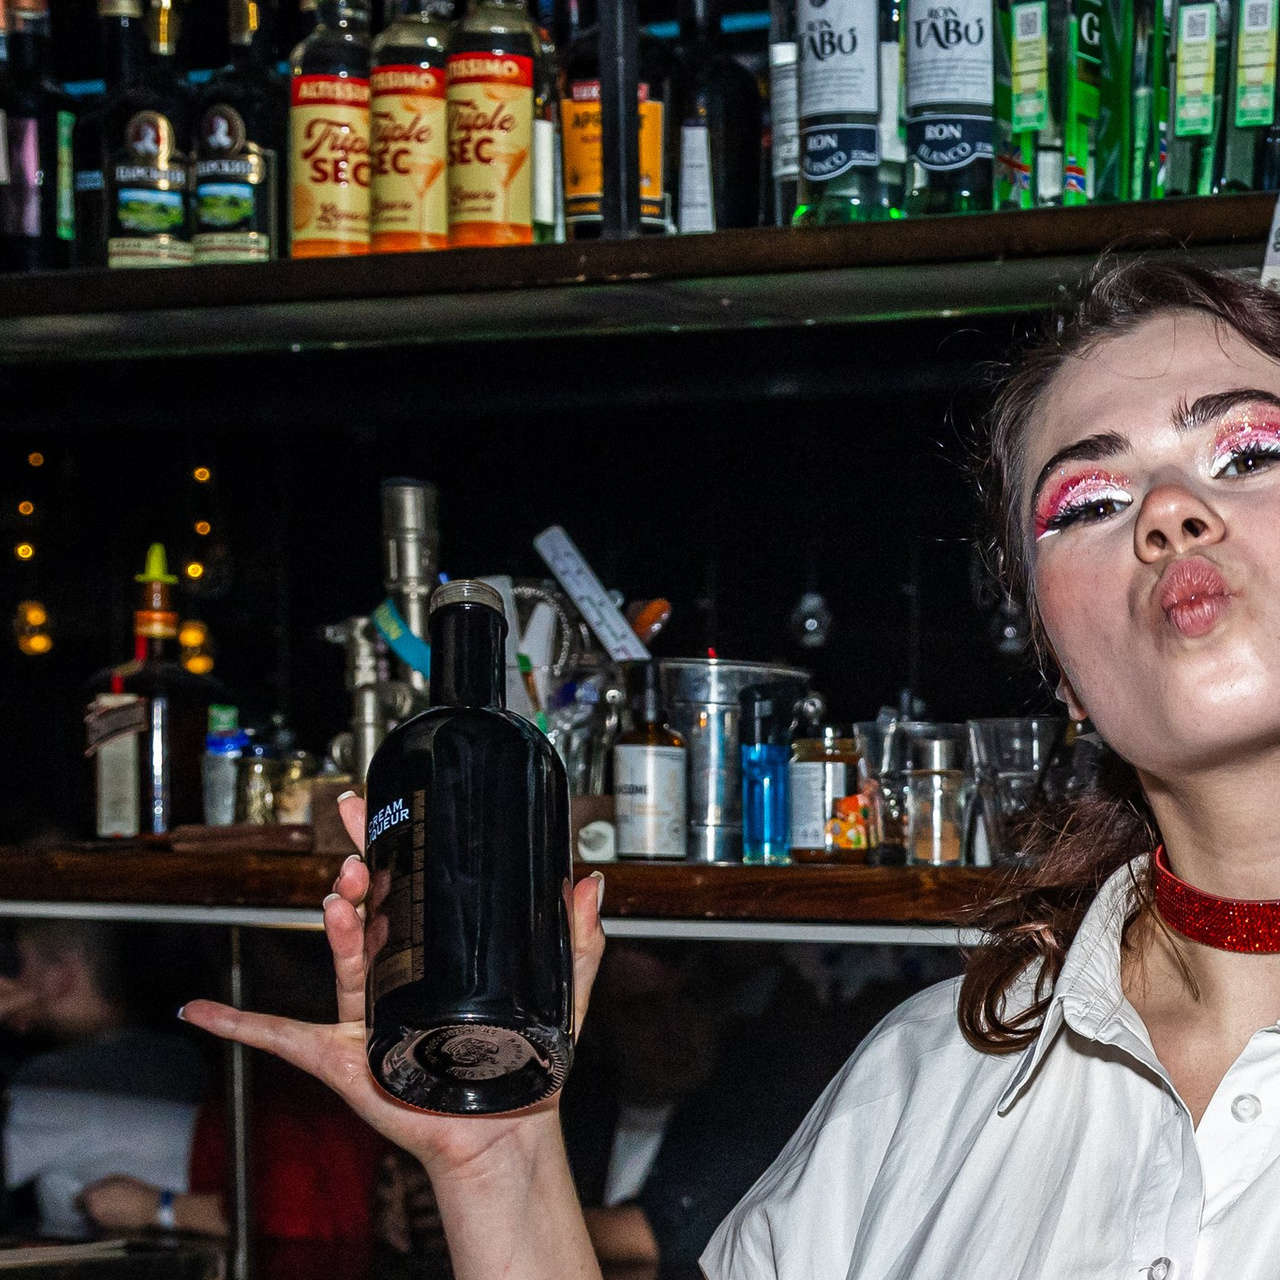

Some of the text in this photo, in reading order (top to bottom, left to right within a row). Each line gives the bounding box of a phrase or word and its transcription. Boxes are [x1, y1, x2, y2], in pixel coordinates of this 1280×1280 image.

[802, 26, 858, 61] ABÚ
[914, 17, 984, 49] TABÚ
[925, 123, 962, 141] RON
[369, 798, 403, 833] CREAM
